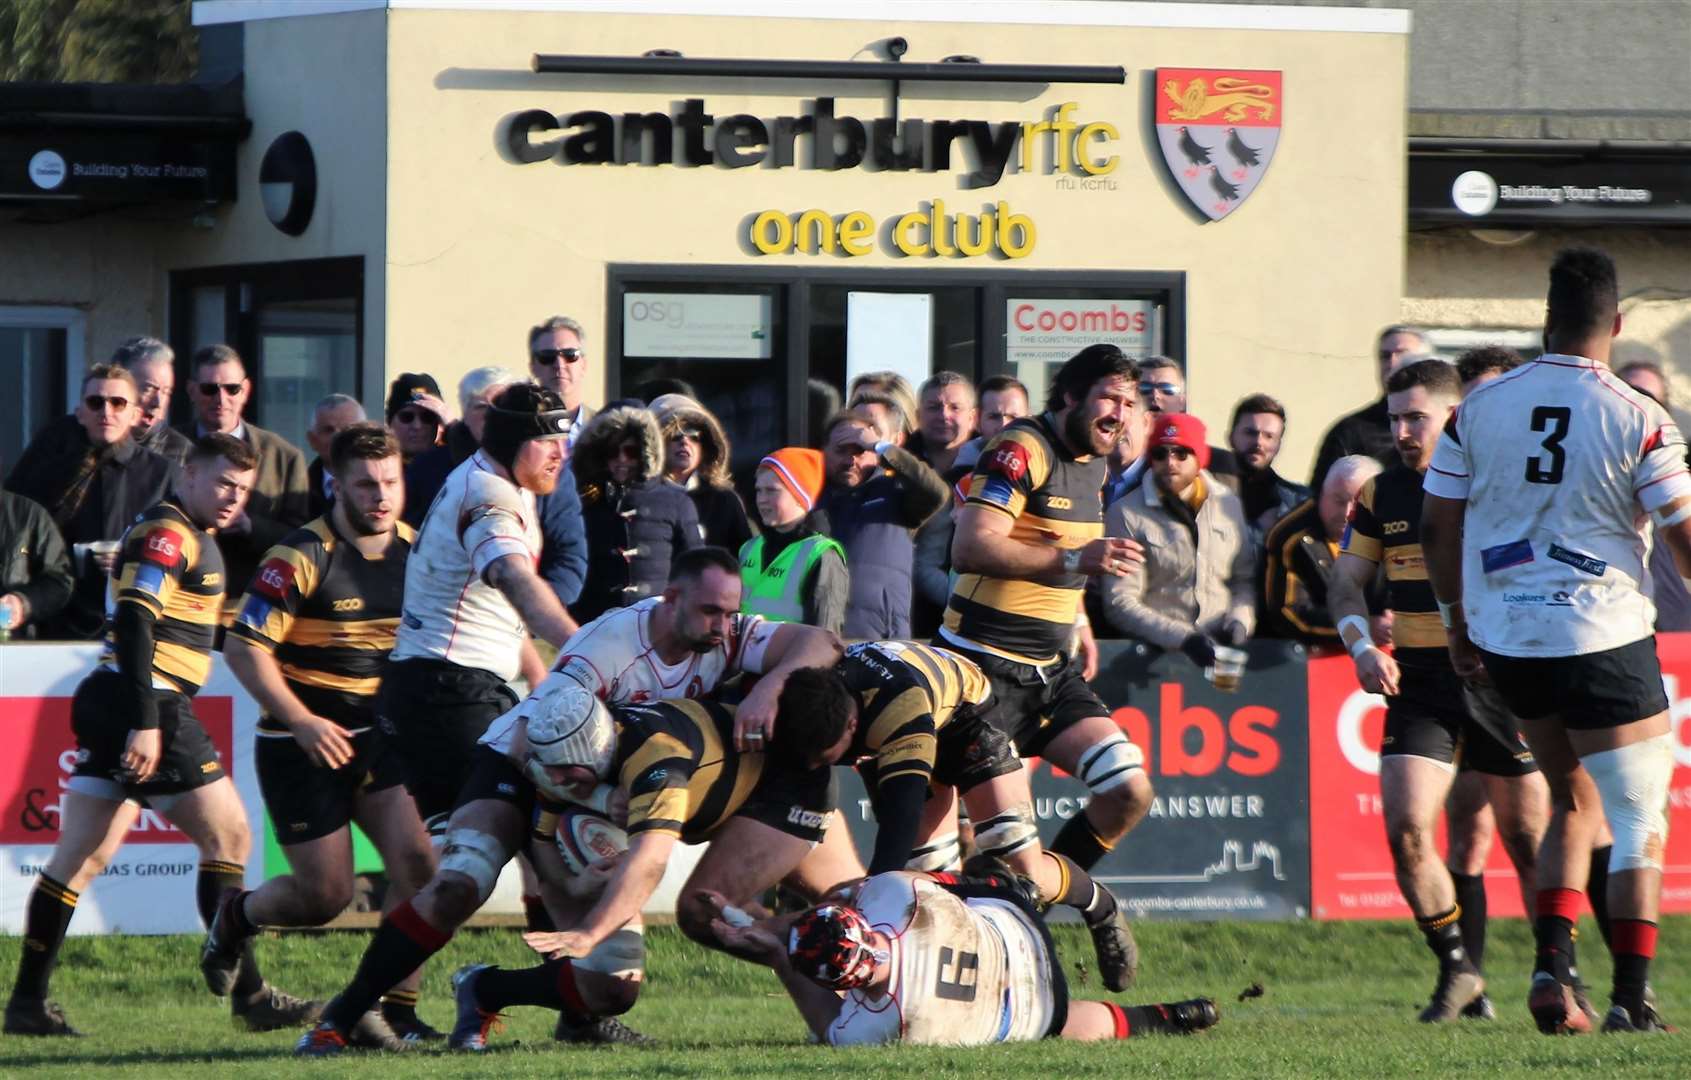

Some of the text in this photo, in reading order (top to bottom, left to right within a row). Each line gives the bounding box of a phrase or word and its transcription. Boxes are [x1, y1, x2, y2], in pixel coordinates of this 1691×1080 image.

[1500, 185, 1562, 202] Building
[1563, 186, 1597, 199] Your
[1599, 186, 1651, 201] Future
[752, 199, 1037, 258] one club
[1014, 303, 1147, 332] Coombs
[1525, 406, 1571, 484] 3
[996, 450, 1020, 471] tfs
[149, 537, 175, 556] tfs
[261, 568, 284, 589] tfs
[1150, 796, 1265, 819] ANSWER
[135, 863, 193, 876] GROUP
[936, 945, 979, 1002] 6
